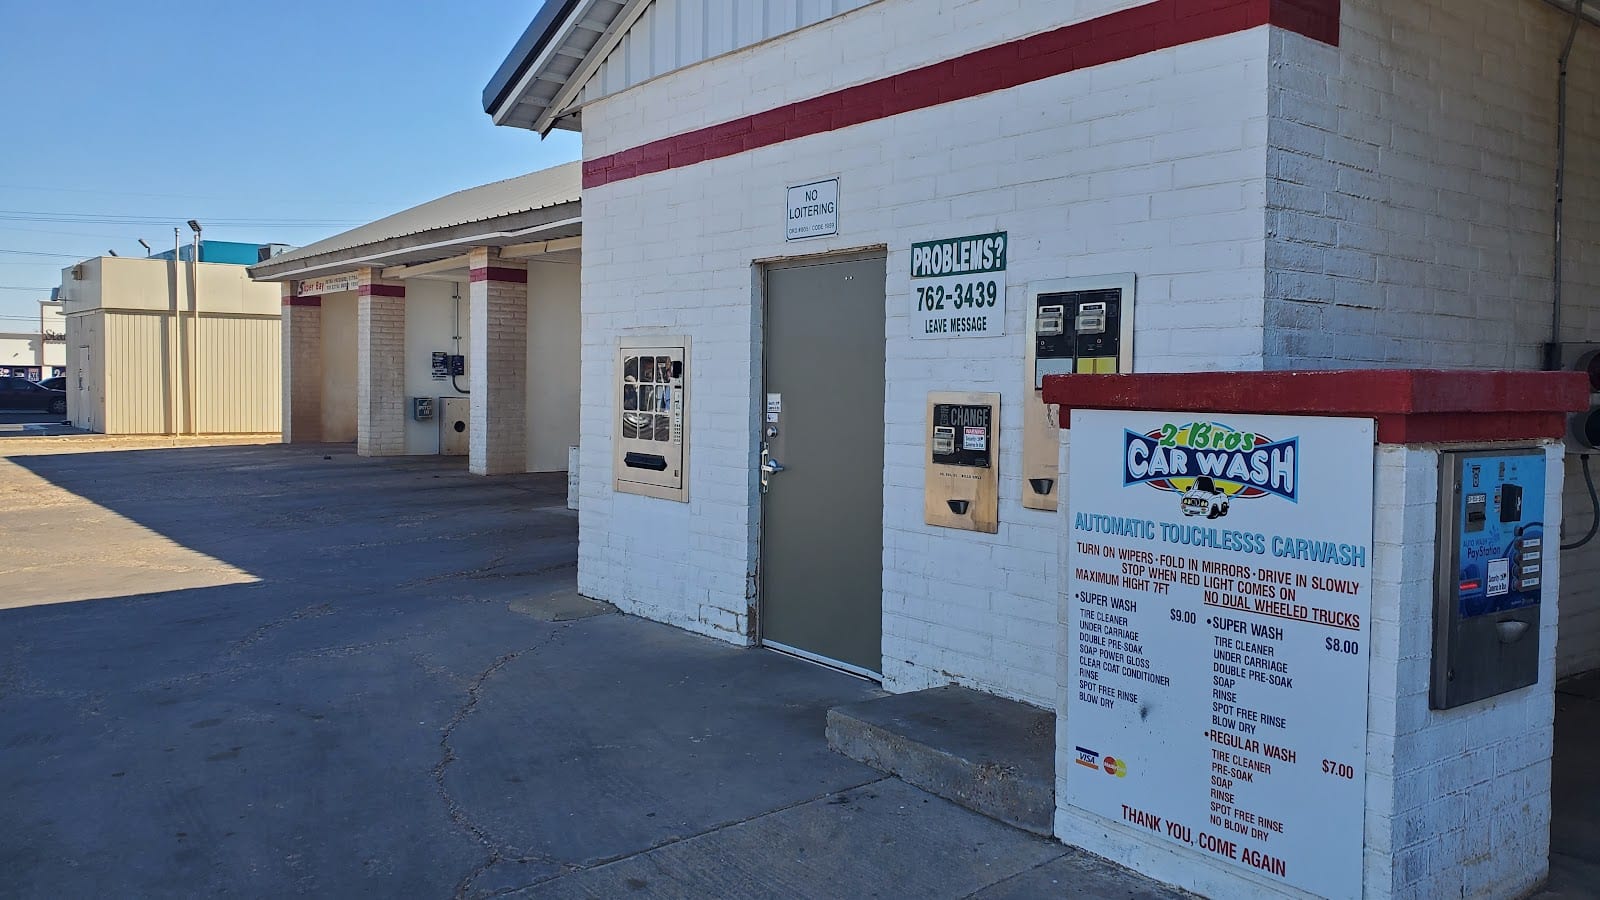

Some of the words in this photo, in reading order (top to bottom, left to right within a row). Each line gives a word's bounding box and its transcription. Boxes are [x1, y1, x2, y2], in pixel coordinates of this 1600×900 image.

[806, 190, 818, 202] NO
[790, 202, 834, 220] LOITERING
[913, 236, 1004, 276] PROBLEMS?
[916, 281, 997, 312] 762-3439
[925, 318, 948, 334] LEAVE
[950, 316, 987, 332] MESSAGE
[950, 408, 988, 427] CHANGE
[1160, 423, 1178, 448] 2
[1188, 421, 1256, 452] Bros
[1128, 438, 1188, 480] CAR
[1196, 444, 1295, 494] WASH
[1074, 512, 1155, 540] AUTOMATIC
[1160, 522, 1266, 554] TOUCHLESSS
[1271, 534, 1366, 568] CARWASH
[1468, 545, 1500, 560] PayStation
[1077, 542, 1100, 556] TURN
[1103, 546, 1116, 559] ON
[1118, 548, 1154, 564] WIPERS
[1160, 554, 1185, 571] FOLD
[1188, 558, 1198, 572] IN
[1202, 561, 1251, 578] MIRRORS
[1258, 568, 1292, 586] DRIVE
[1296, 574, 1306, 588] IN
[1312, 576, 1360, 596] SLOWLY
[1075, 568, 1119, 586] MAXIMUM
[1122, 576, 1150, 592] HIGHT
[1153, 582, 1170, 596] 7FT
[1122, 562, 1146, 578] STOP
[1149, 567, 1176, 583] WHEN
[1180, 571, 1200, 586] RED
[1204, 574, 1234, 592] LIGHT
[1237, 580, 1276, 599] COMES
[1279, 586, 1296, 602] ON
[1080, 591, 1108, 610] SUPER
[1110, 596, 1137, 613] WASH
[1204, 591, 1219, 606] NO
[1222, 594, 1251, 610] DUAL
[1254, 598, 1308, 620] WHEELED
[1312, 606, 1360, 628] TRUCKS
[1080, 608, 1094, 622] TIRE
[1096, 612, 1128, 626] CLEANER
[1170, 608, 1197, 625] $9.00
[1080, 620, 1102, 635] UNDER
[1104, 625, 1140, 642] CARRIAGE
[1212, 617, 1248, 636] SUPER
[1251, 624, 1284, 642] WASH
[1080, 632, 1106, 648] DOUBLE
[1108, 638, 1144, 654] PRE-SOAK
[1214, 636, 1232, 649] TIRE
[1236, 640, 1274, 657] CLEANER
[1325, 637, 1359, 655] $8.00
[1080, 644, 1098, 658] SOAP
[1100, 648, 1124, 664] POWER
[1126, 654, 1150, 669] GLOSS
[1214, 648, 1242, 664] UNDER
[1244, 656, 1288, 674] CARRIAGE
[1080, 656, 1101, 670] CLEAR
[1102, 662, 1120, 675] COAT
[1122, 666, 1170, 688] CONDITIONER
[1080, 668, 1099, 682] RINSE
[1212, 675, 1236, 690] SOAP
[1213, 662, 1246, 678] DOUBLE
[1248, 669, 1292, 688] PRE-SOAK
[1079, 692, 1098, 706] BLOW
[1100, 696, 1114, 710] DRY
[1080, 680, 1096, 694] SPOT
[1099, 684, 1116, 698] FREE
[1118, 688, 1138, 704] RINSE
[1212, 688, 1237, 704] RINSE
[1212, 702, 1234, 717] SPOT
[1236, 706, 1258, 722] FREE
[1260, 712, 1286, 729] RINSE
[1212, 716, 1236, 731] BLOW
[1238, 720, 1256, 735] DRY
[1080, 752, 1095, 764] VISA
[1210, 730, 1260, 754] REGULAR
[1263, 744, 1296, 764] WASH
[1212, 749, 1230, 764] TIRE
[1232, 754, 1271, 775] CLEANER
[1212, 762, 1254, 784] PRE-SOAK
[1322, 759, 1354, 780] $7.00
[1211, 776, 1233, 790] SOAP
[1210, 788, 1235, 804] RINSE
[1210, 802, 1232, 816] SPOT
[1234, 808, 1256, 824] FREE
[1258, 814, 1284, 834] RINSE
[1210, 814, 1222, 827] NO
[1224, 817, 1250, 836] BLOW
[1251, 826, 1270, 842] DRY
[1122, 804, 1162, 832] THANK
[1166, 819, 1195, 846] YOU,
[1198, 832, 1237, 859] COME
[1241, 848, 1286, 878] AGAIN
